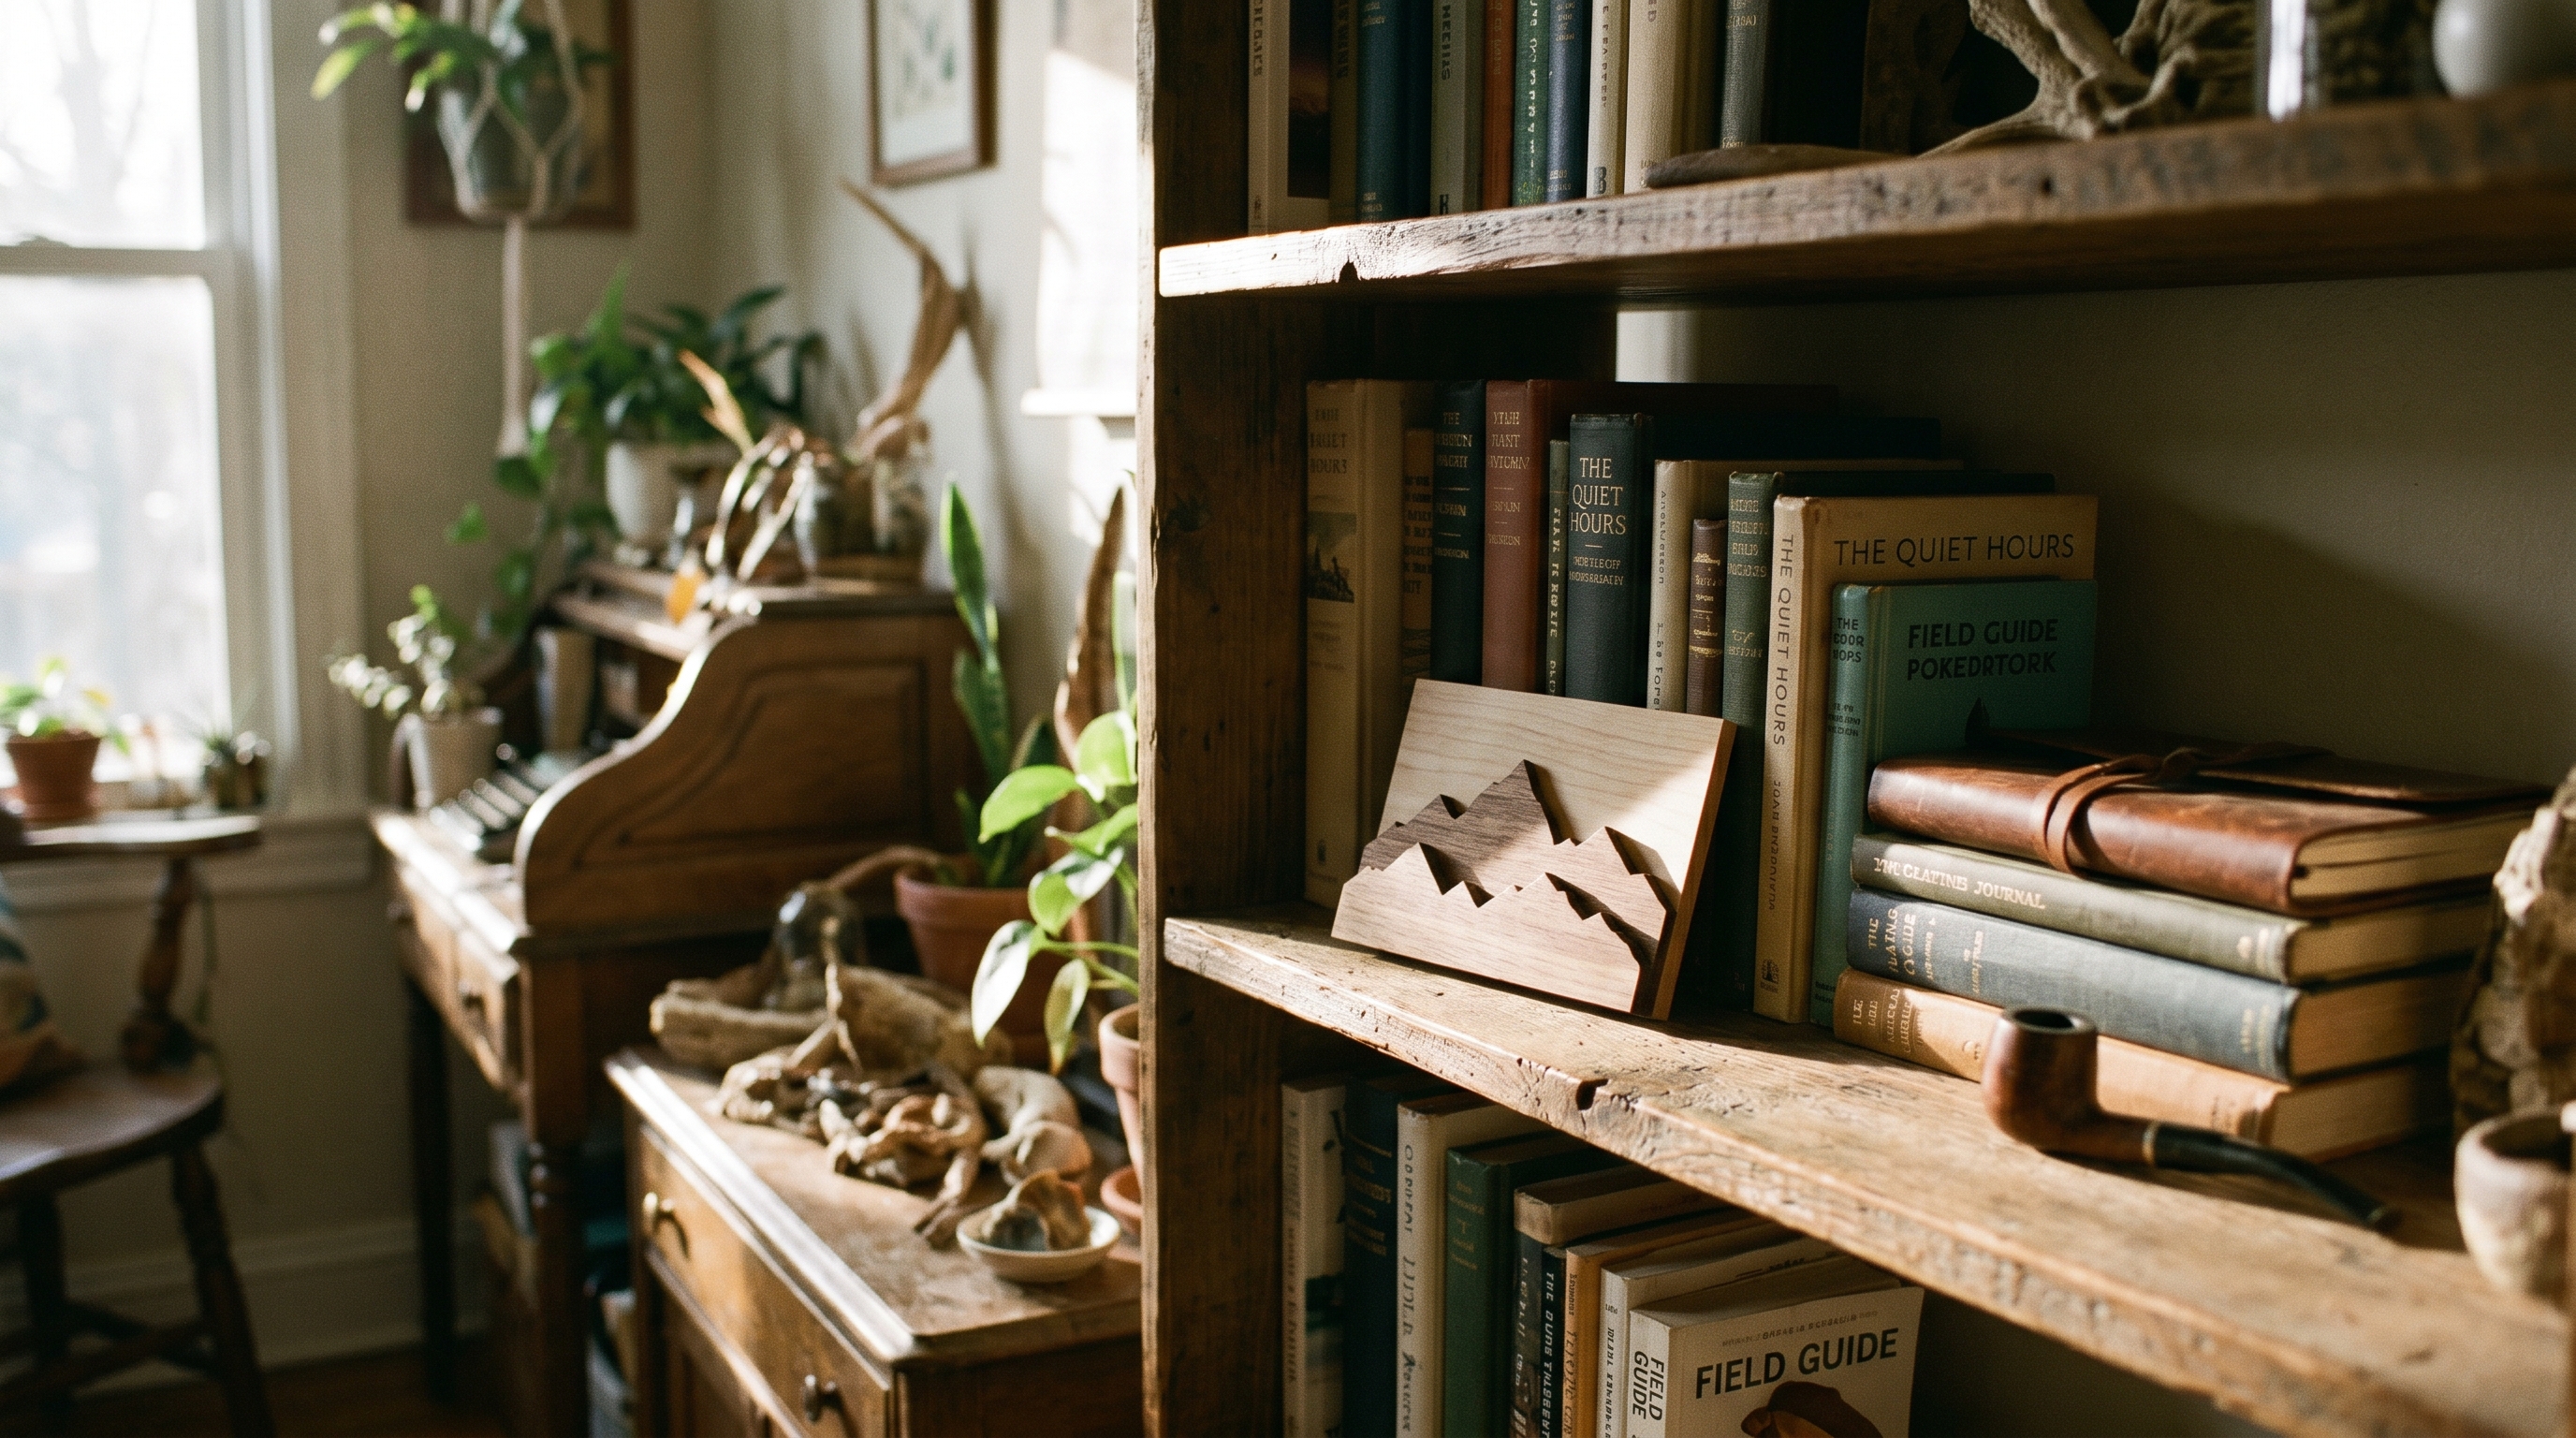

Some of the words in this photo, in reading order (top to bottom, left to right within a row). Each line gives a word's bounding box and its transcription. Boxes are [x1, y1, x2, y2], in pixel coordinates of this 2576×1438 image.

[1579, 457, 1613, 479] THE
[1572, 483, 1624, 510] QUIET
[1570, 511, 1627, 536] HOURS
[1780, 535, 1794, 579] THE
[1834, 538, 1886, 566] THE
[1896, 536, 1979, 568] QUIET
[1987, 533, 2076, 562] HOURS
[1777, 587, 1792, 659] QUIET
[1837, 617, 1859, 630] THE
[1908, 622, 1976, 650] FIELD
[1983, 618, 2059, 646] GUIDE
[1773, 667, 1789, 746] HOURS
[1974, 880, 2046, 910] JOURNAL
[1695, 1351, 1786, 1400] FIELD
[1797, 1328, 1899, 1376] GUIDE
[1632, 1350, 1649, 1419] GUIDE
[1648, 1357, 1664, 1421] FIELD
